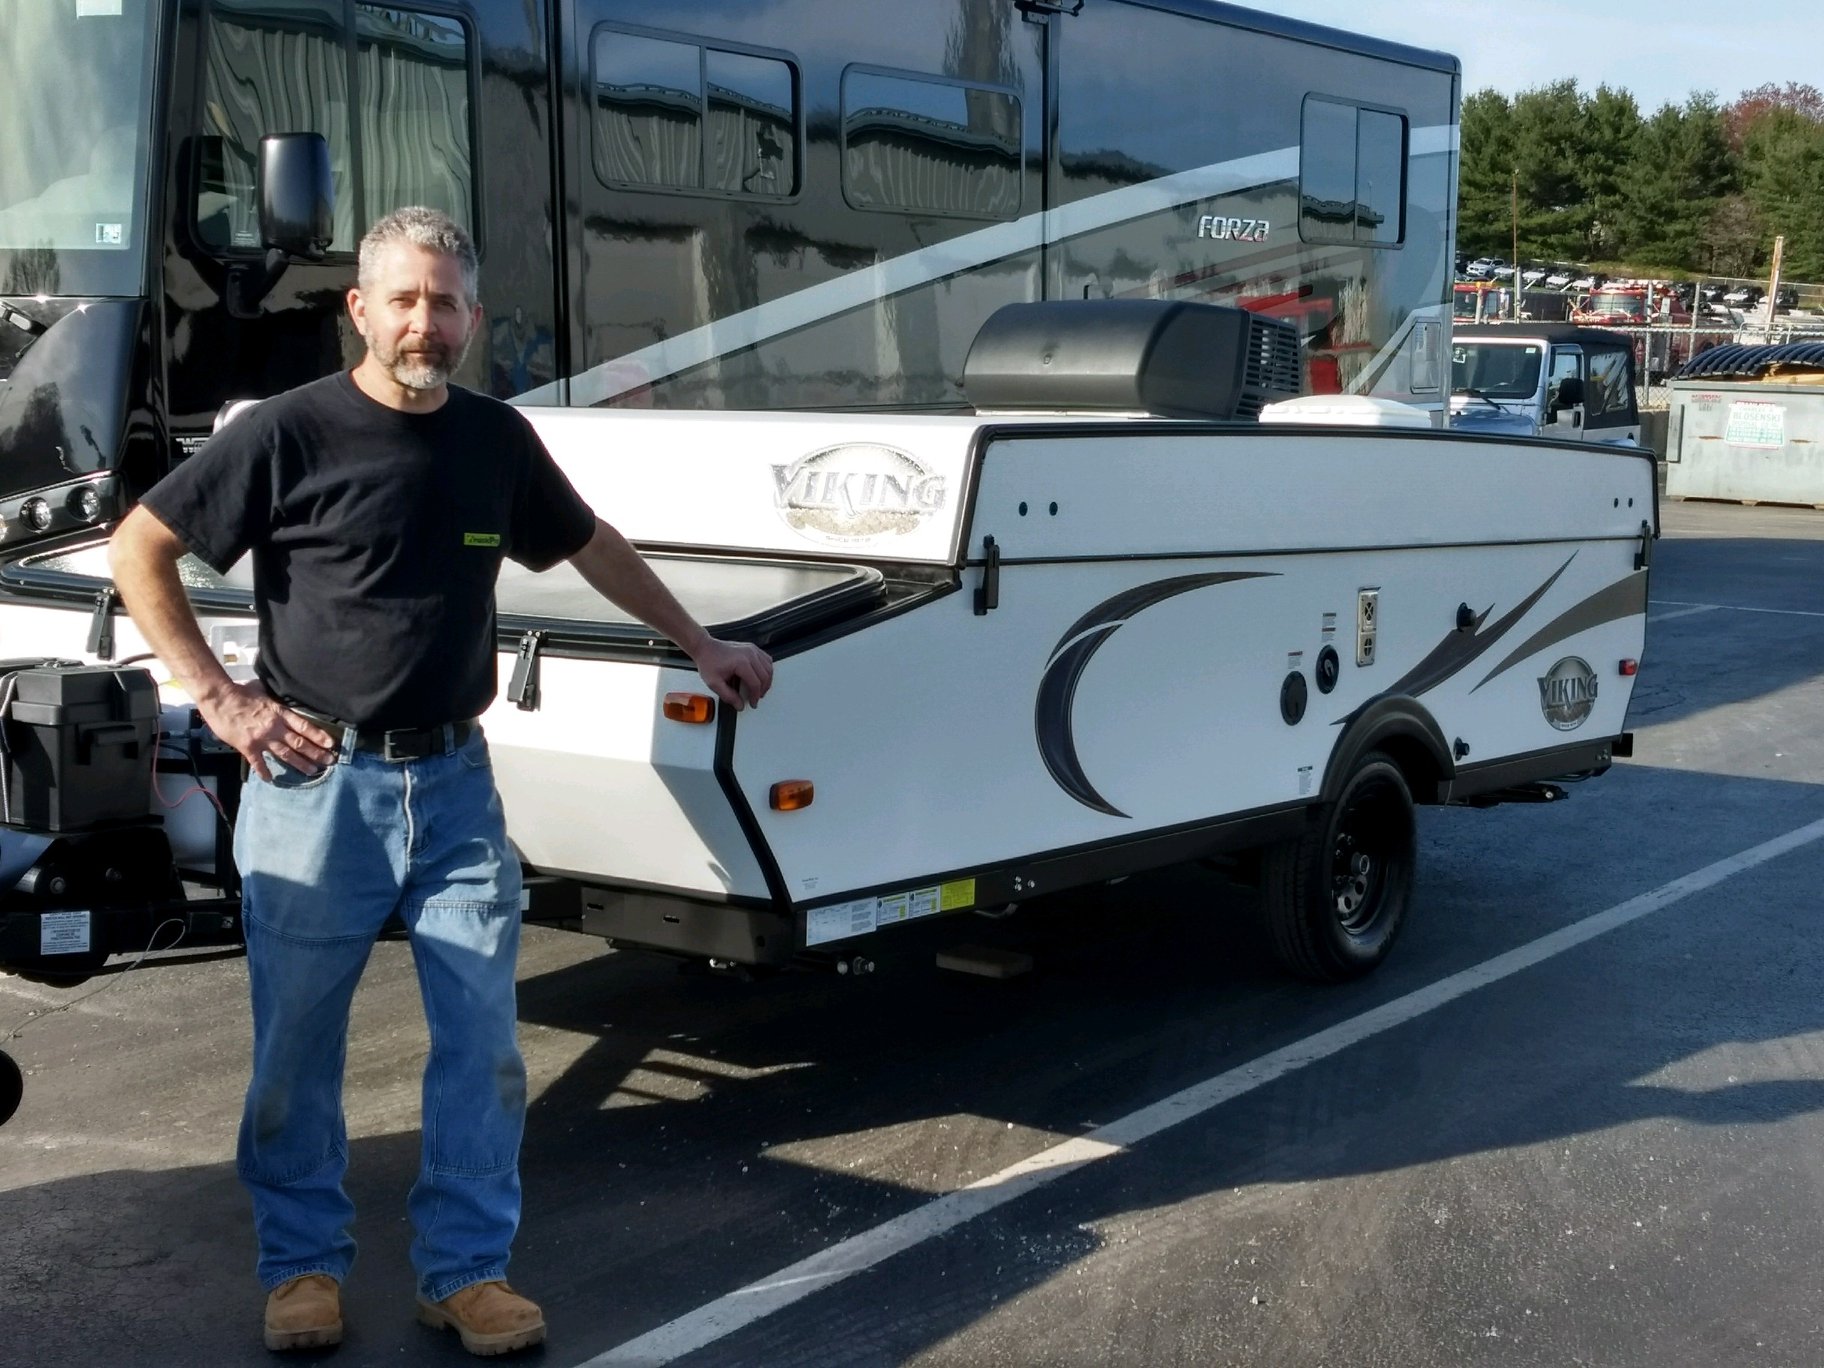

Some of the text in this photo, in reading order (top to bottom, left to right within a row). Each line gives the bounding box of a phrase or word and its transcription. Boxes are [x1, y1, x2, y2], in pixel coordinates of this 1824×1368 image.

[1198, 215, 1270, 242] FORZA
[770, 463, 947, 518] VIKING
[1537, 674, 1598, 710] VIKING
